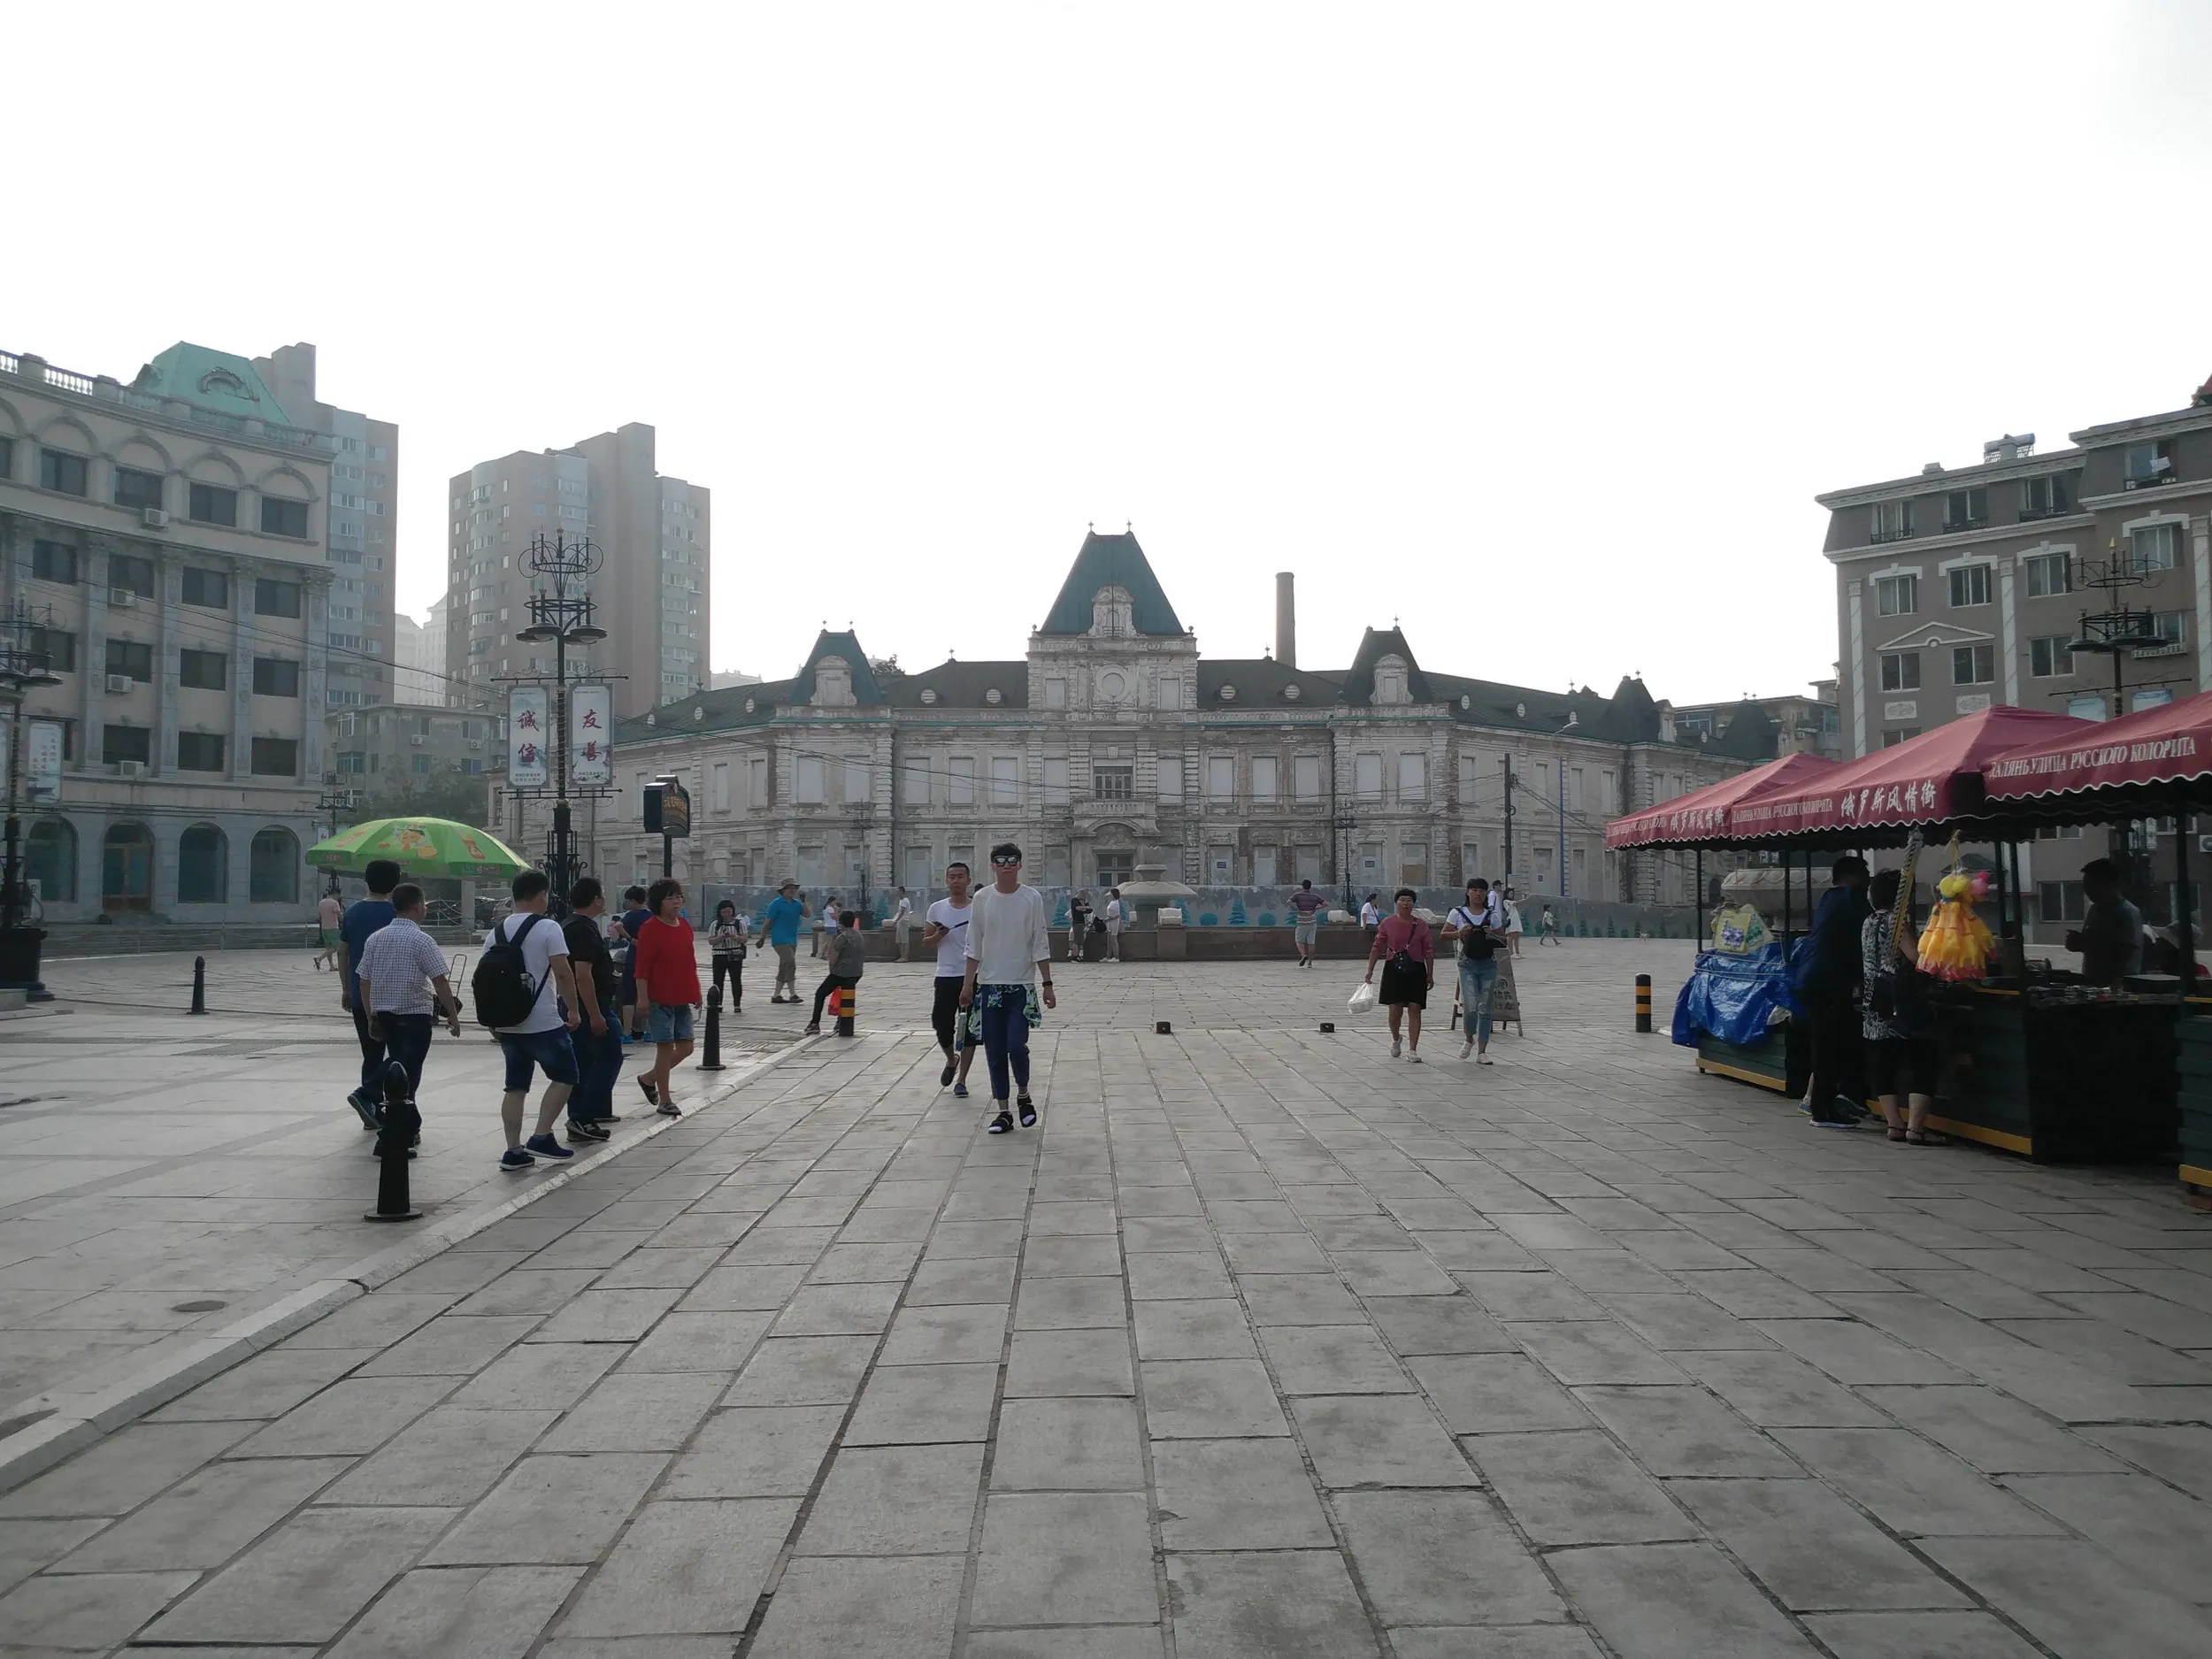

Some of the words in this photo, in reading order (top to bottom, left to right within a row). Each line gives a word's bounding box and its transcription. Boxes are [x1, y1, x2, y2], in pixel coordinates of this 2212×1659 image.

[580, 709, 602, 762] 友善
[2028, 754, 2067, 774] УЛИЦА
[2070, 745, 2127, 770] РУССКОГО
[2130, 736, 2196, 763] КОЛОРИТА
[1840, 779, 1937, 819] 俄罗斯风情街
[1670, 805, 1724, 833] 俄罗斯风情街
